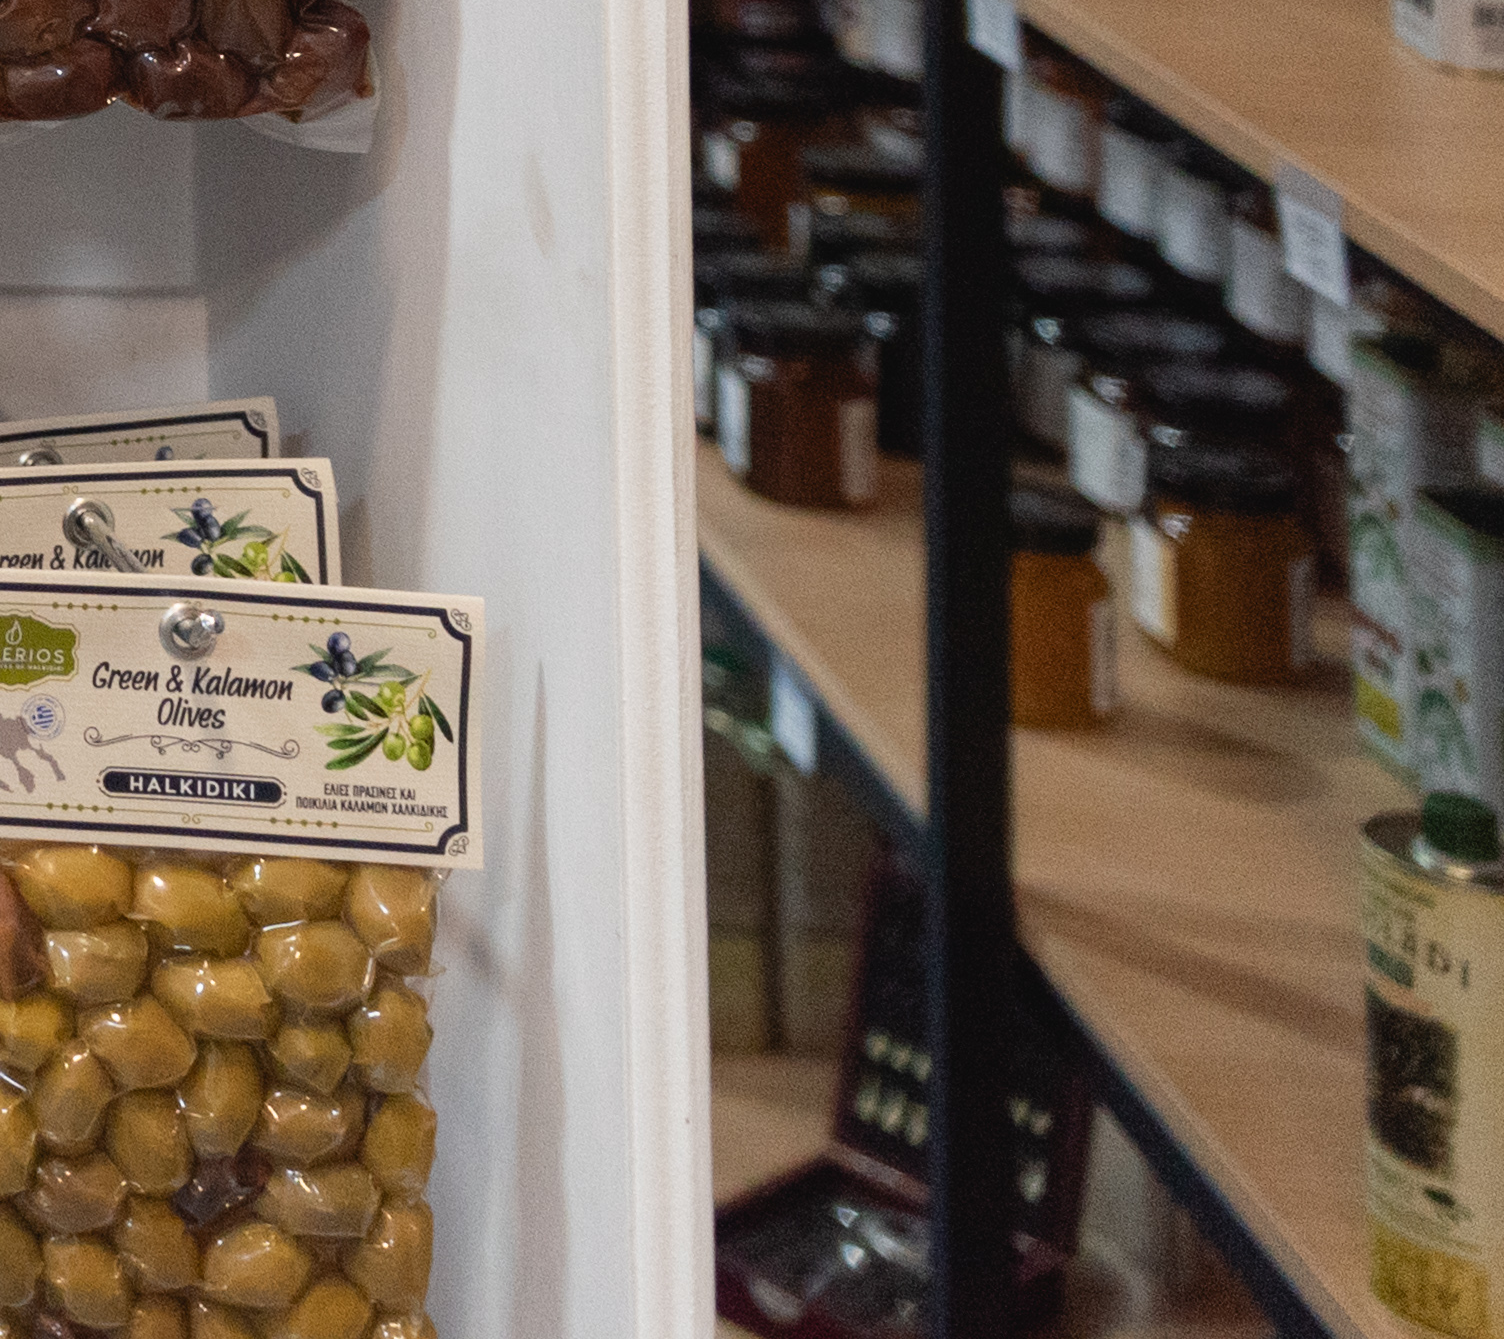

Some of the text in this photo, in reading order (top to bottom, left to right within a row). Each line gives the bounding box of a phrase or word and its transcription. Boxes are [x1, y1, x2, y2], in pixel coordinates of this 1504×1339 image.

[50, 545, 65, 570] &
[92, 661, 293, 700] Green & Kalamon
[158, 697, 225, 729] Olives
[129, 776, 256, 801] HALKIDIKI
[324, 783, 415, 800] ΕΛΙΕΣ ΠΡΑΣΙΝΕΣ ΚΑΙ
[296, 796, 448, 818] ΠΟΙΚΙΛΙΑ ΚΑΛΑΜΩΝ ΧΑΛΚΙΔΙΚΗΣ
